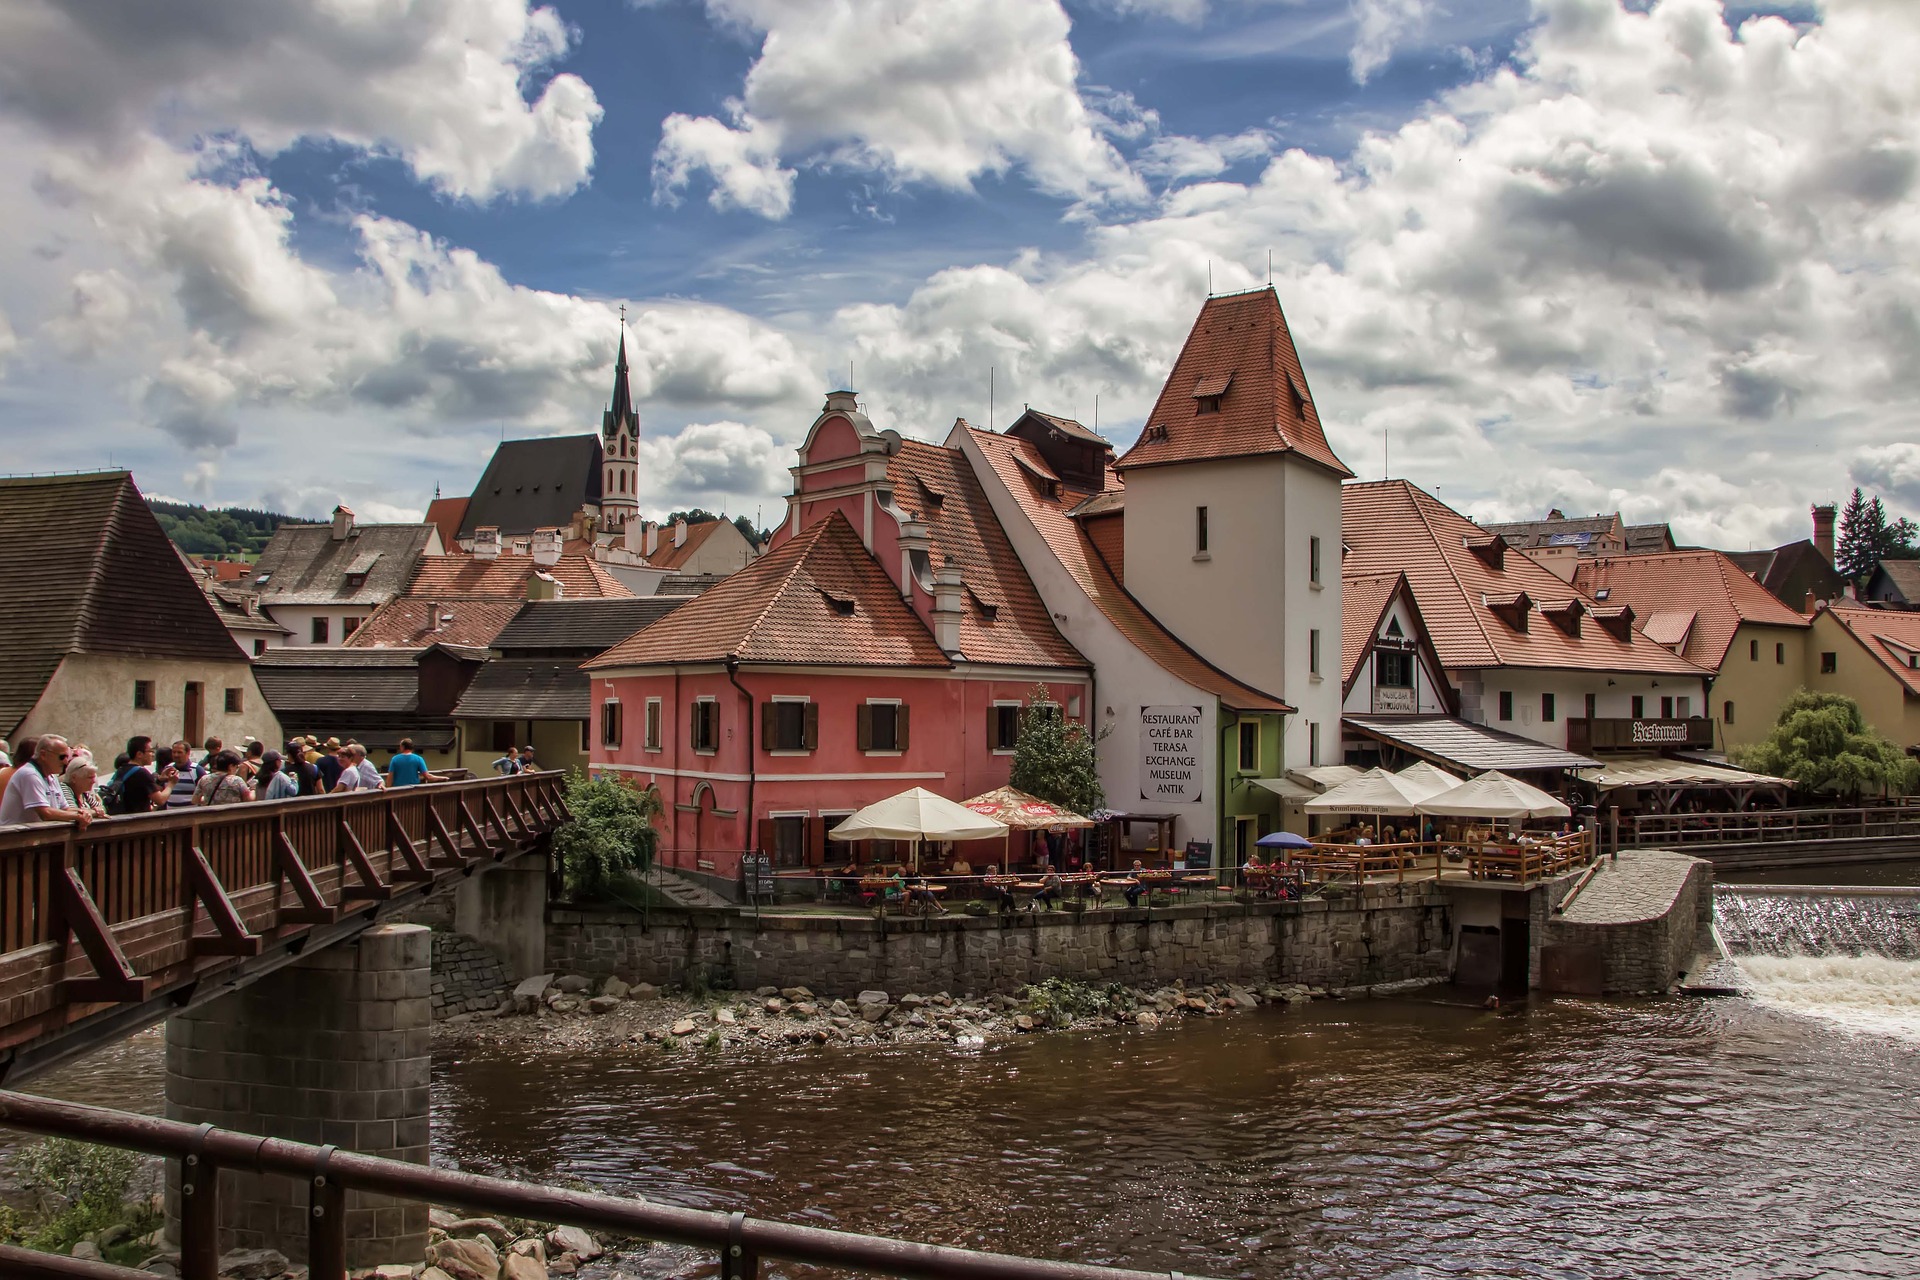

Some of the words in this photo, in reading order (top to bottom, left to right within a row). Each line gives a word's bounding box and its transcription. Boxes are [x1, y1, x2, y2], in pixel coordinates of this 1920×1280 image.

[1142, 714, 1200, 725] RESTAURANT
[1149, 726, 1172, 738] CAFÉ
[1174, 728, 1194, 739] BAR
[1632, 721, 1687, 742] Restaurant
[1153, 742, 1188, 752] TERASA
[1145, 755, 1196, 767] EXCHANGE
[1149, 769, 1192, 780] MUSEUM
[1156, 783, 1185, 794] ANTIK
